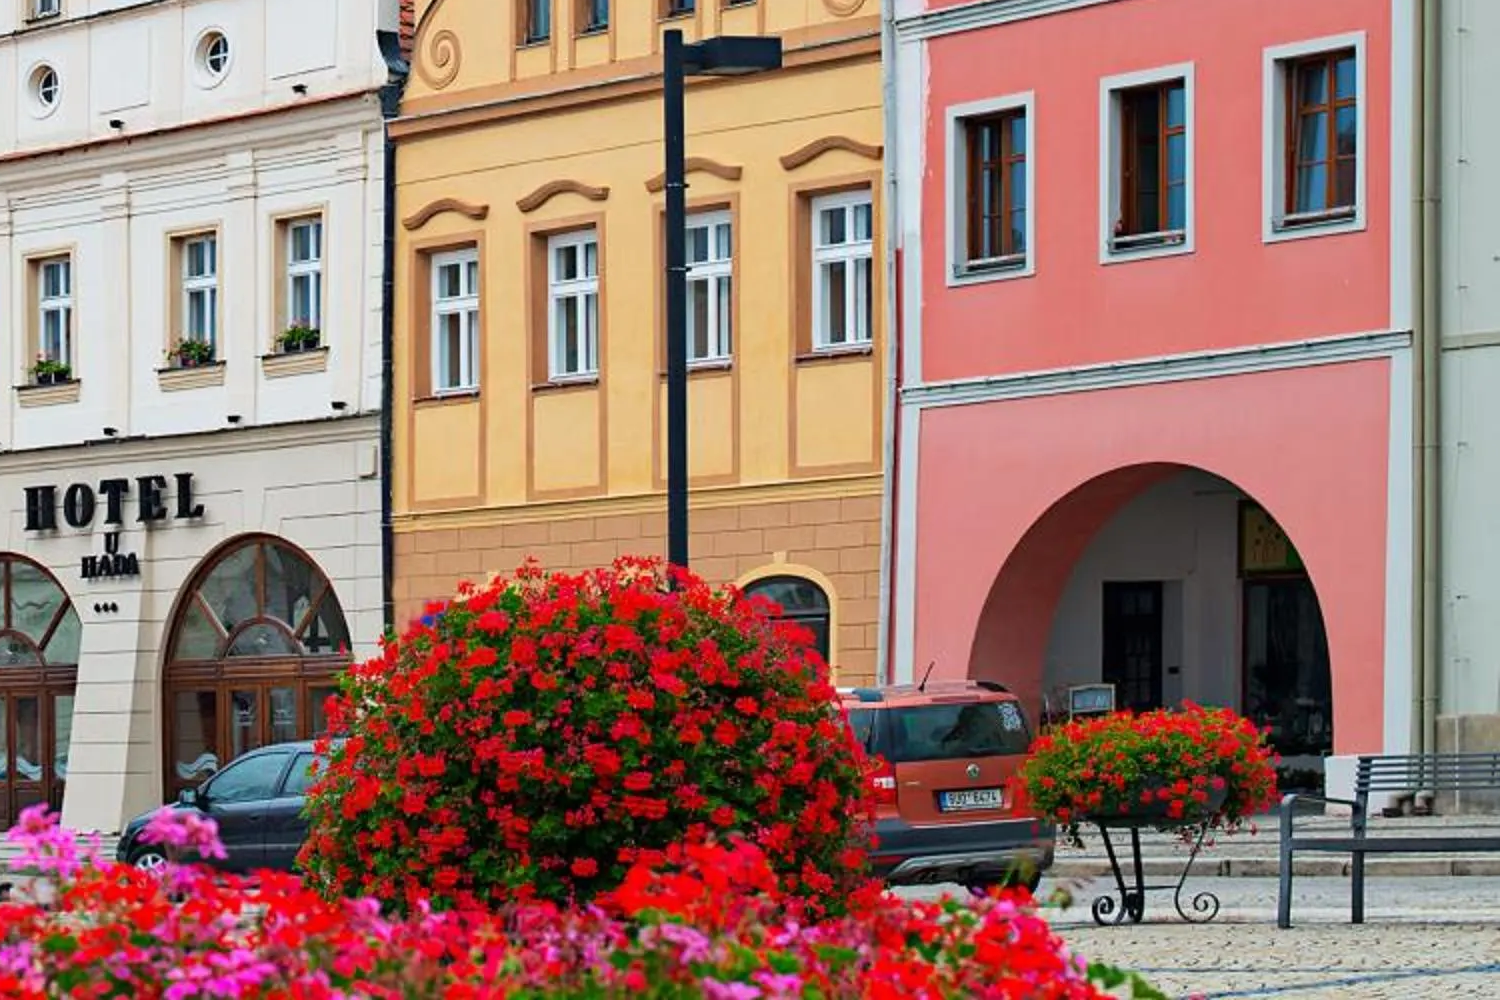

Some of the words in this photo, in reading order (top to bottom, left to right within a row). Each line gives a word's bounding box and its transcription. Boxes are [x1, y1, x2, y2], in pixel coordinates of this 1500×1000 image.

[24, 473, 204, 531] HOTEL
[104, 531, 119, 554] U
[81, 552, 140, 578] HADA
